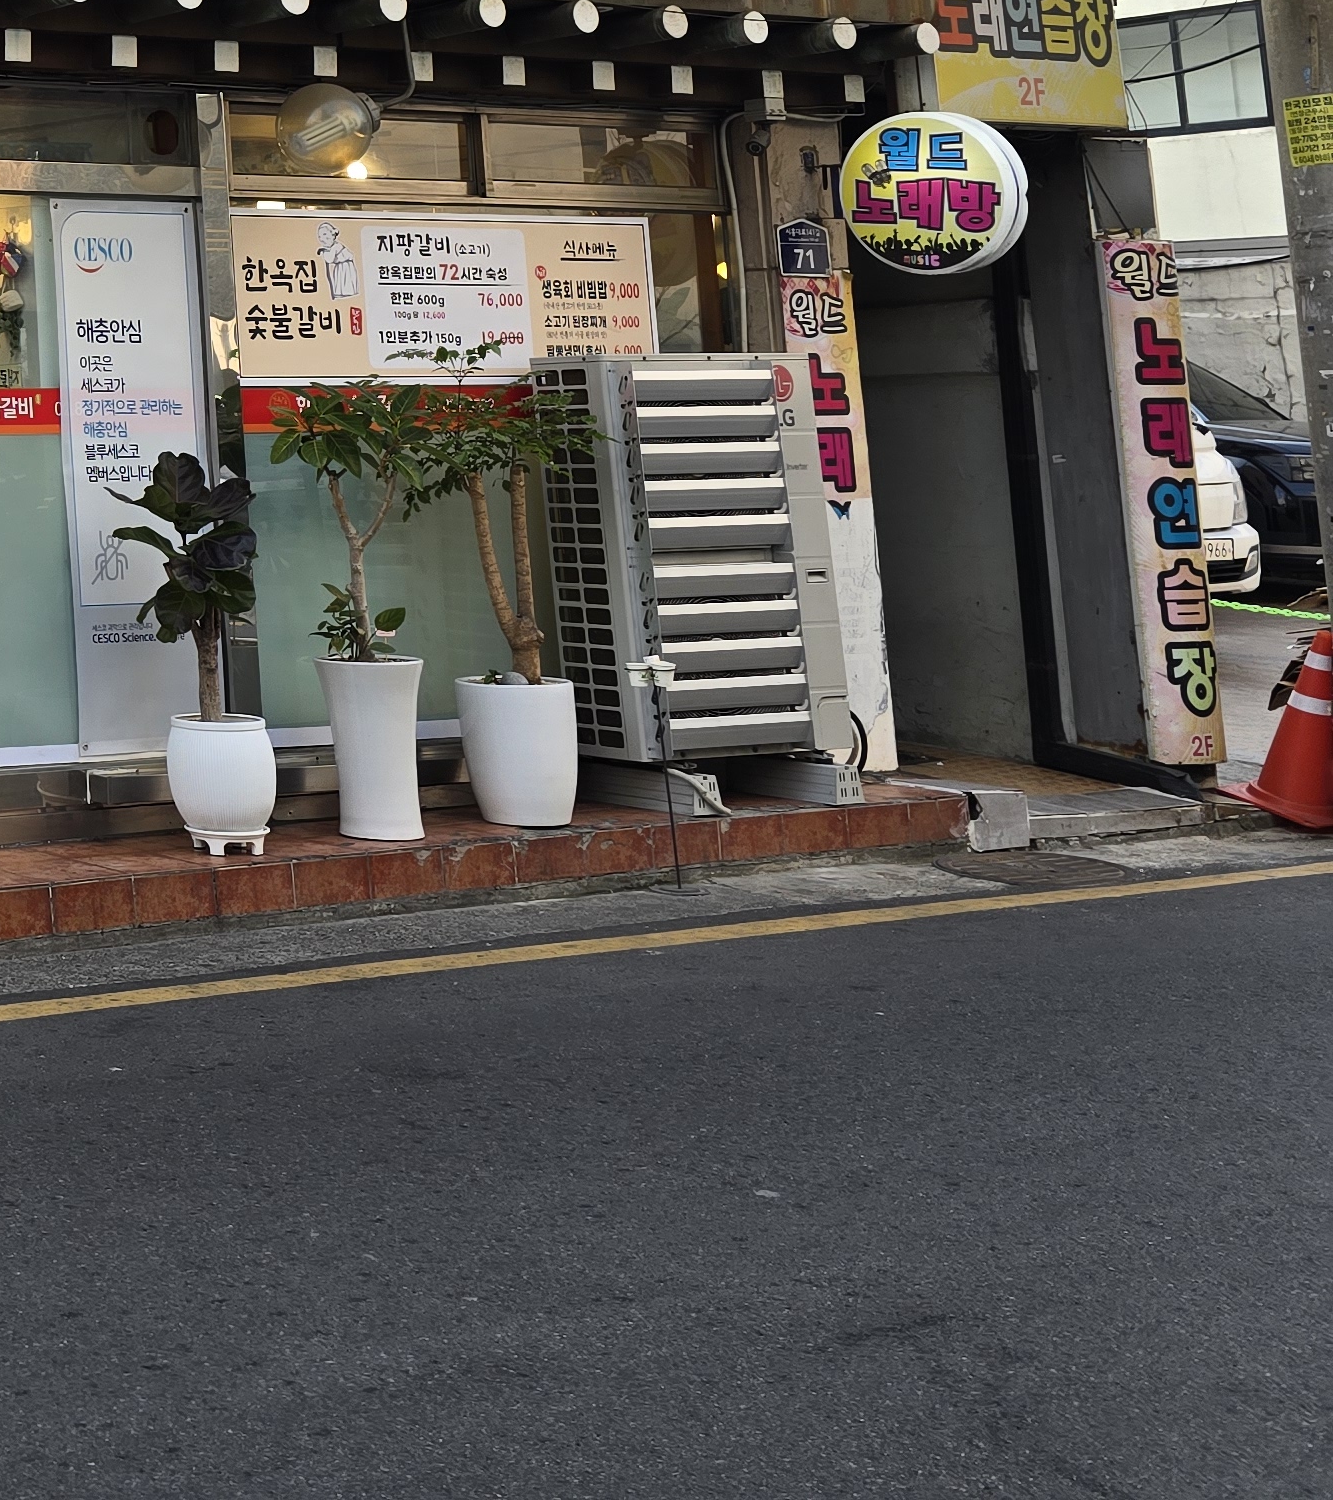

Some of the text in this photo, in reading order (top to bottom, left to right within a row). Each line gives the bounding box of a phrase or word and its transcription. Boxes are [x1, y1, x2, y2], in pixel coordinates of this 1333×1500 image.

[1018, 77, 1045, 106] 2F
[879, 127, 967, 172] 월드
[851, 177, 1001, 233] 노래방
[74, 237, 133, 262] CESCO
[376, 233, 491, 257] 지팡갈비 (소고기)
[563, 240, 617, 258] 식사메뉴
[793, 248, 815, 269] 71
[242, 256, 318, 293] 한옥집
[378, 266, 437, 280] 한옥집만의
[485, 267, 508, 281] 숙성
[1110, 249, 1179, 301] 월드
[390, 292, 523, 308] 한판 600g 76,000
[542, 280, 640, 301] 생육회 비빔밥 9,000
[245, 304, 341, 340] 숯불갈비
[544, 315, 640, 330] 소고기 된장찌개 9,000
[789, 289, 848, 338] 월드
[76, 318, 142, 343] 해충안심
[378, 330, 433, 344] 1인분추가
[435, 332, 462, 346] 150g
[80, 356, 113, 372] 이곳은
[81, 378, 126, 394] 세스코가
[82, 400, 138, 416] 정기적으로
[139, 399, 183, 416] 관리하는
[780, 409, 796, 426] G
[83, 421, 128, 438] 해충안심
[84, 443, 141, 460] 블루세스코
[86, 465, 153, 482] 멤버스입니다
[1134, 317, 1217, 717] 노래연습장
[1204, 543, 1228, 558] 966
[92, 632, 120, 643] CESCO
[1191, 735, 1214, 757] 2F
